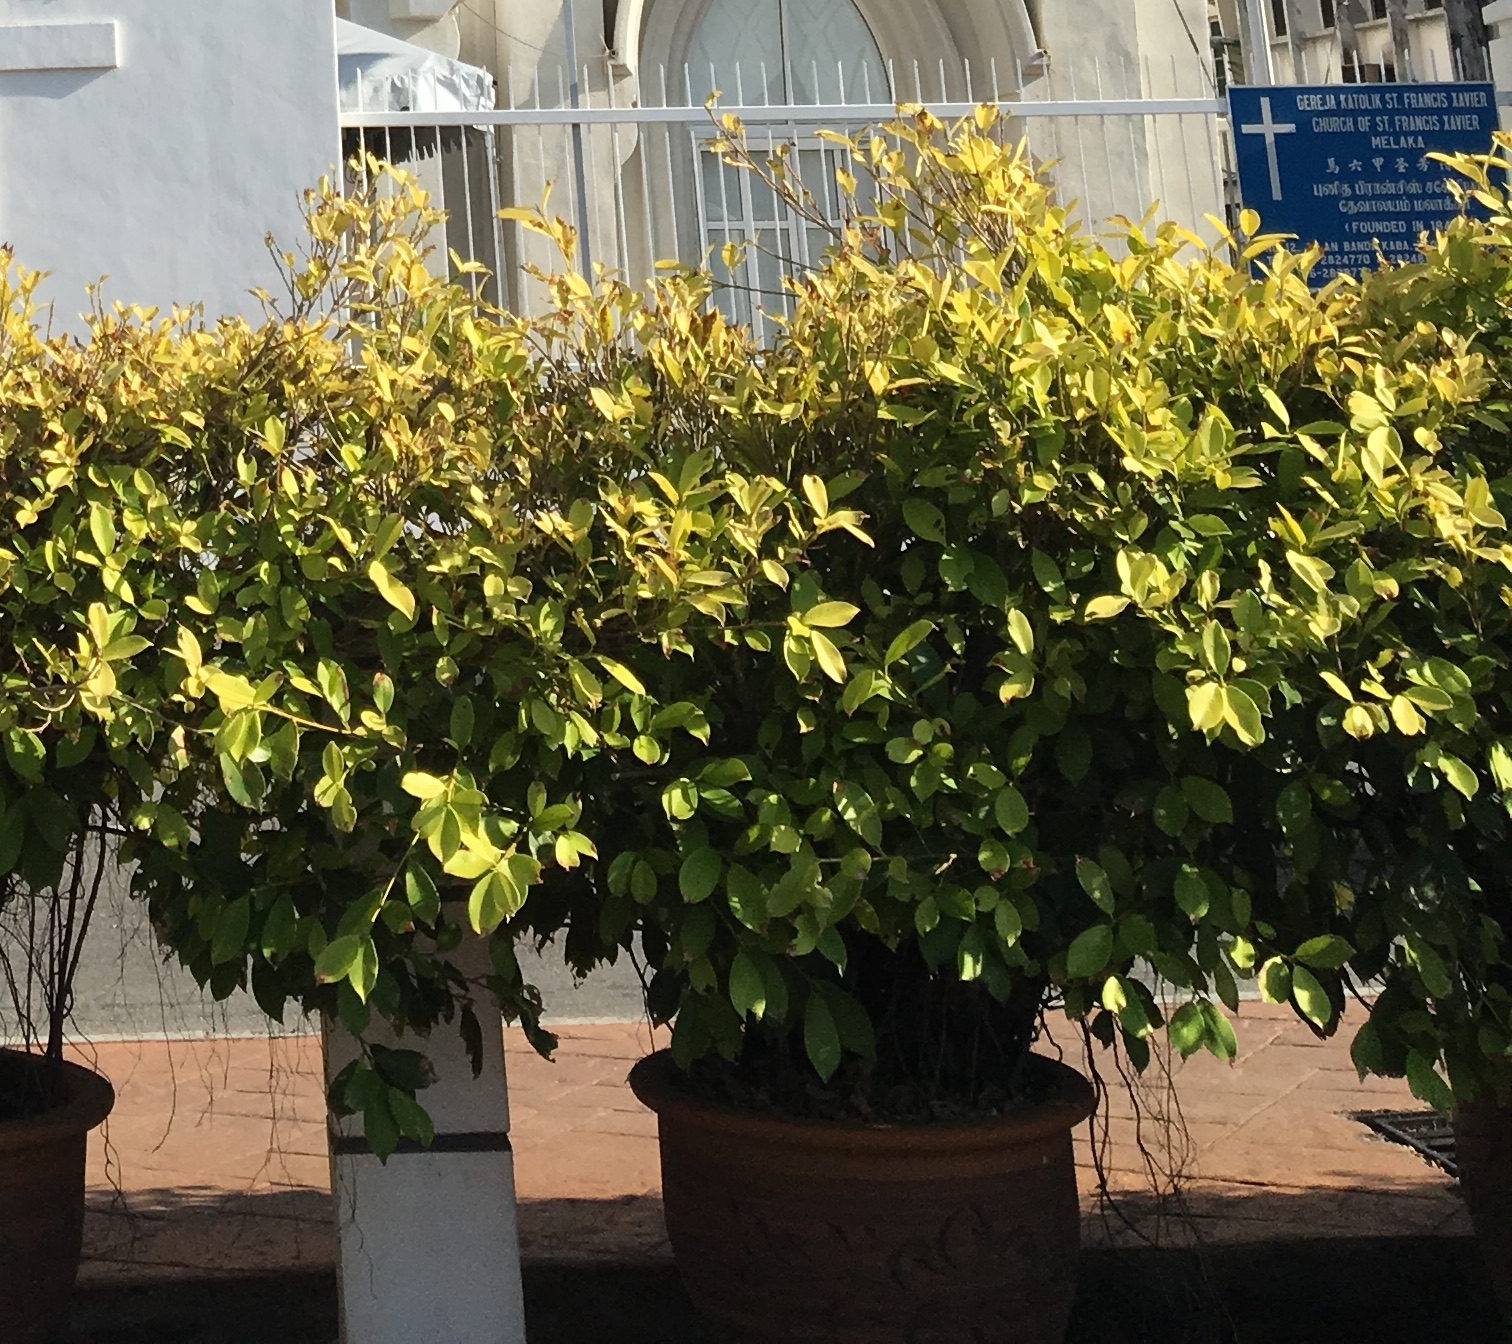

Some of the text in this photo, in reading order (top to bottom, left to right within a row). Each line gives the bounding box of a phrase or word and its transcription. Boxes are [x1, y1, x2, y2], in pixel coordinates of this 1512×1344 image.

[1296, 91, 1488, 111] GEREJA KATOLIK ST. FRANCIS XAVIER
[1312, 114, 1480, 133] CHURCH OF ST. FRANCIS XAVIER
[1371, 135, 1425, 149] MELAKA
[1412, 220, 1424, 232] IN
